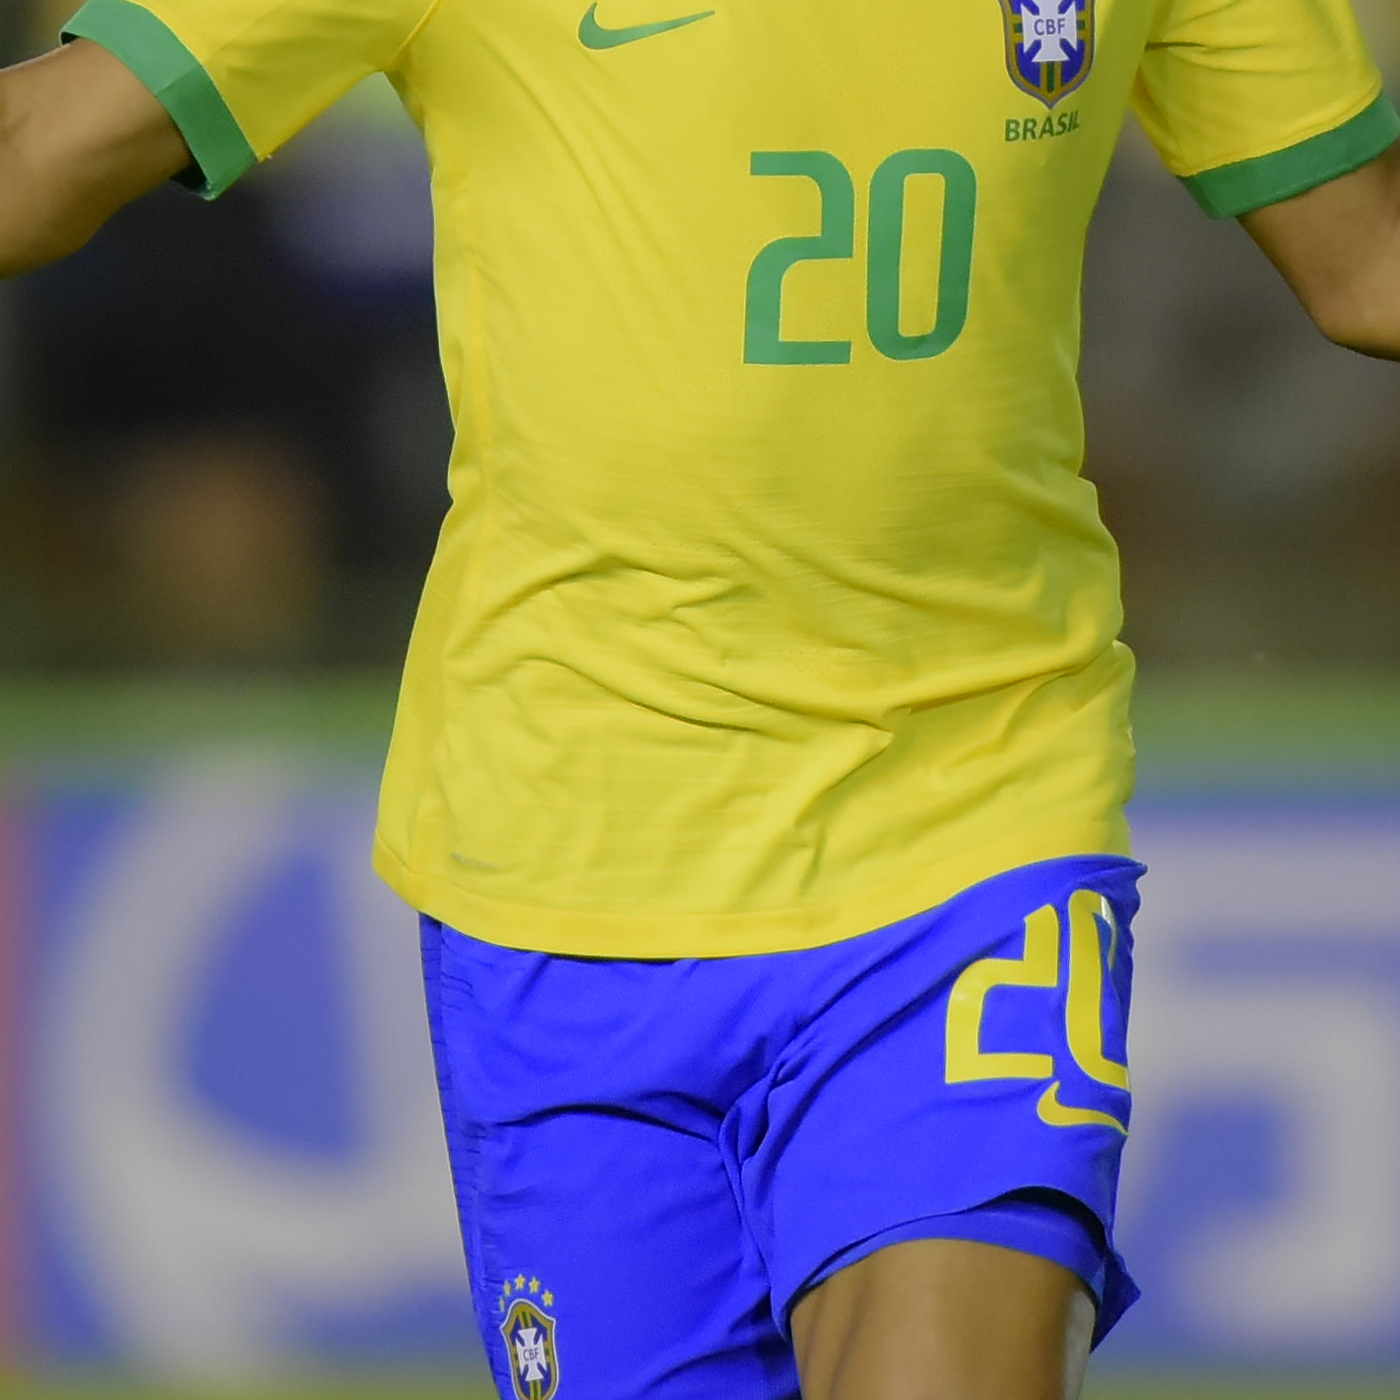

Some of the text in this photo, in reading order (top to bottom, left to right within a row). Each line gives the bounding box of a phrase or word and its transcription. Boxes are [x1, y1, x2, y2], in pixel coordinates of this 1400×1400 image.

[1034, 18, 1066, 36] CBF
[1005, 110, 1079, 141] BRASIL
[743, 148, 977, 365] 20
[523, 1347, 539, 1362] CBF
